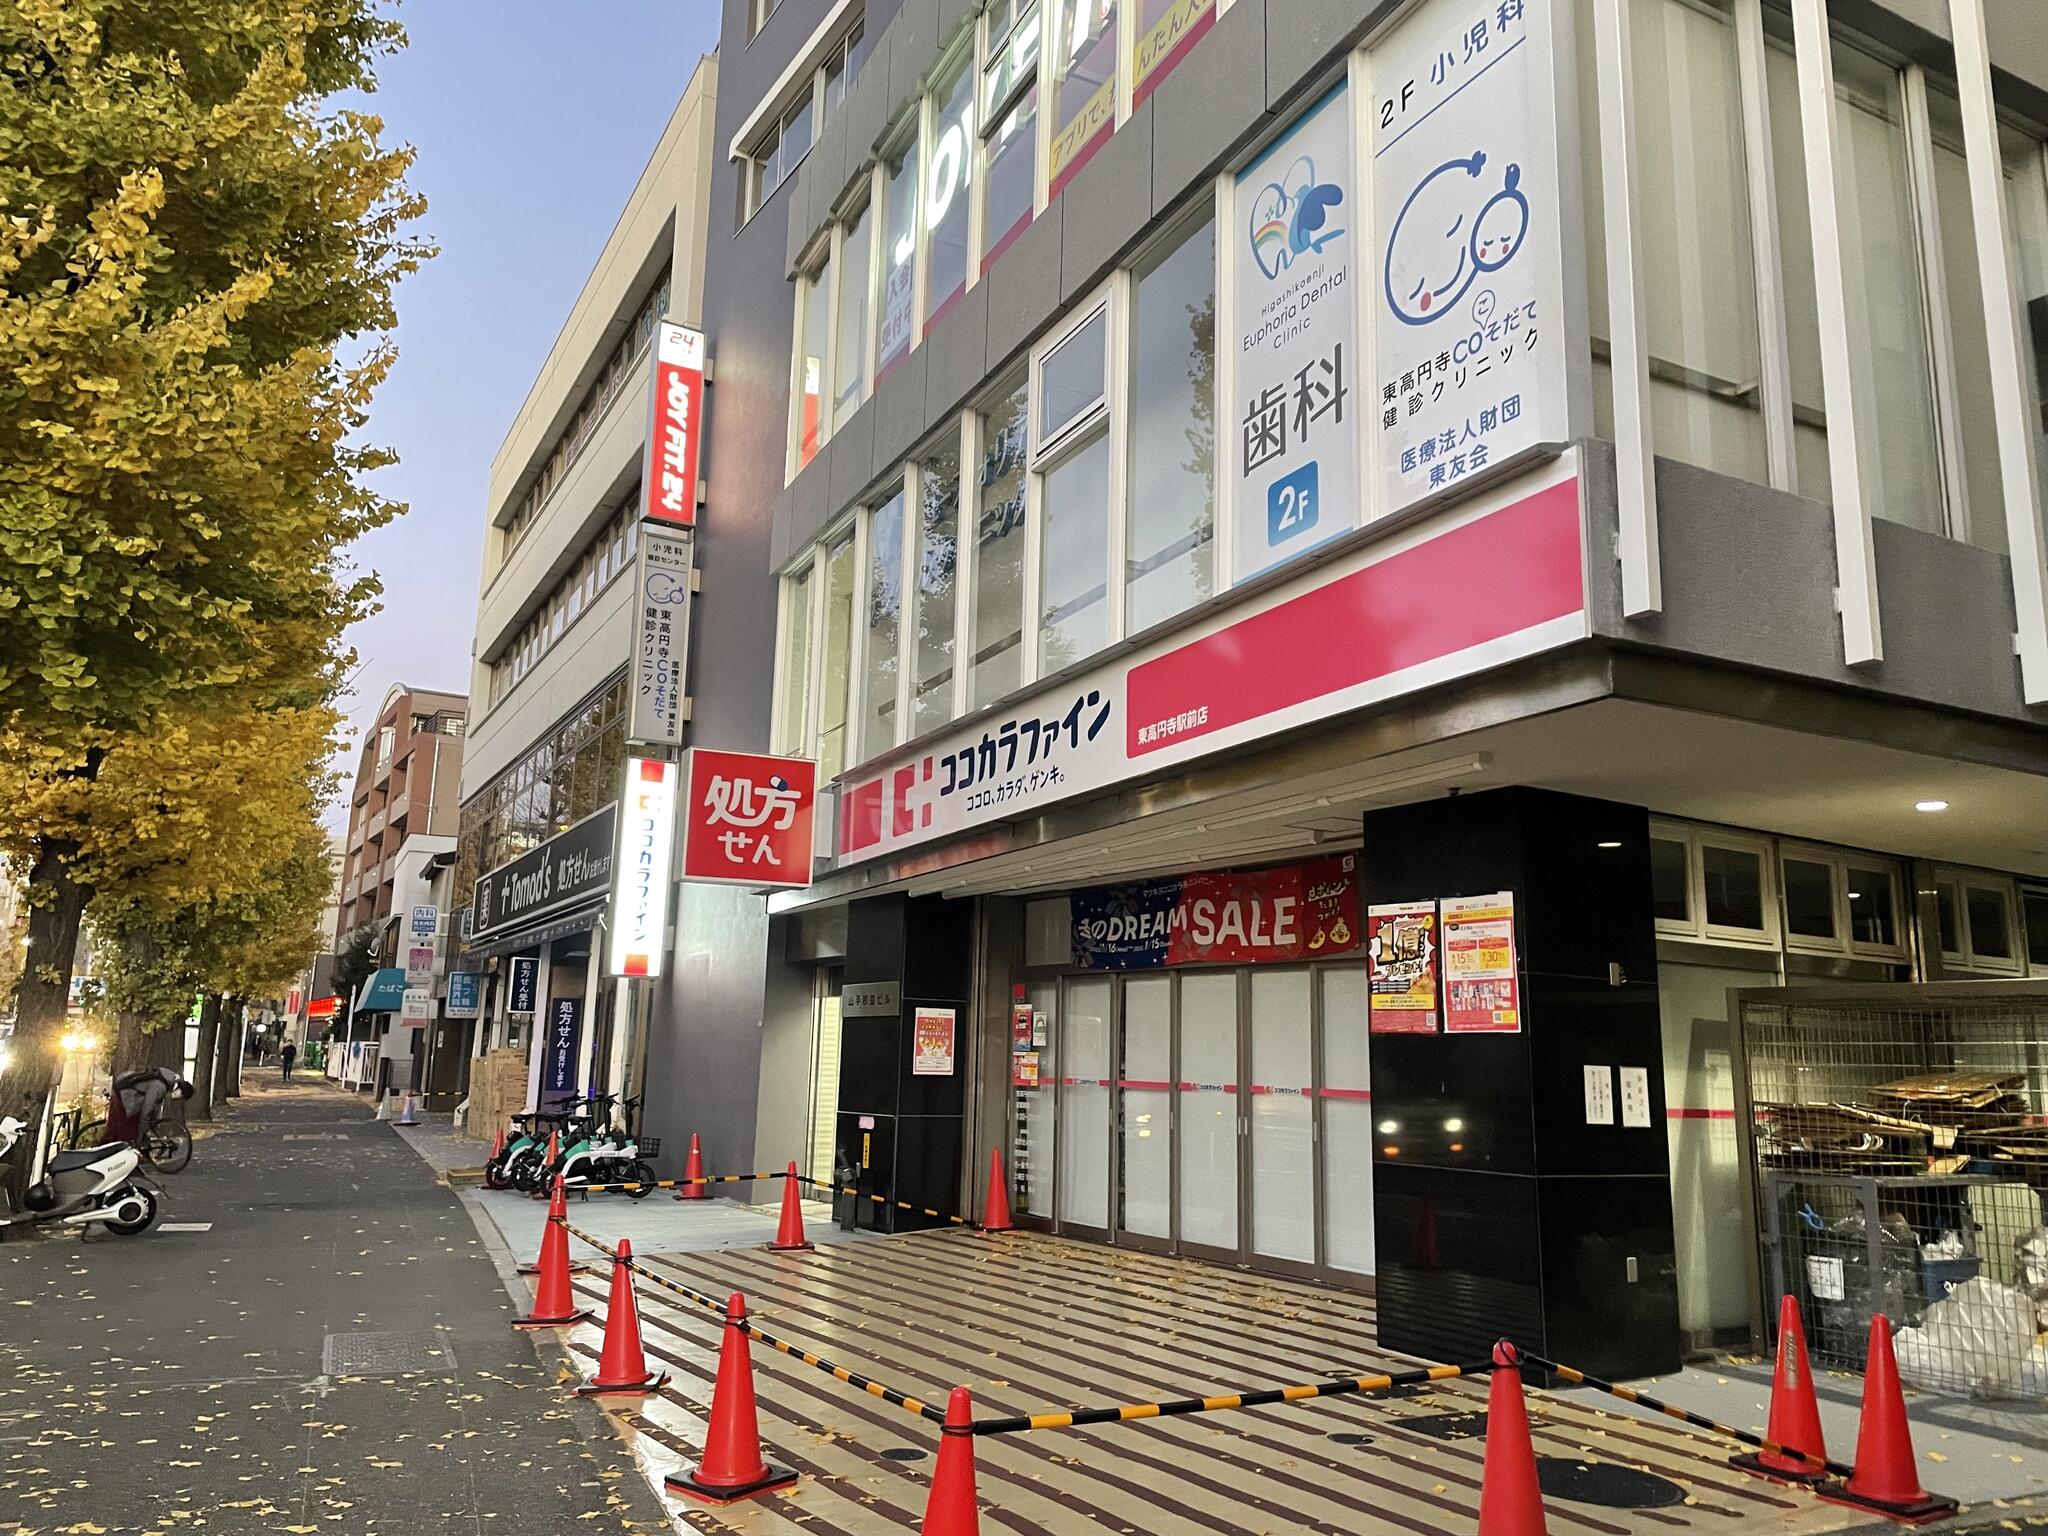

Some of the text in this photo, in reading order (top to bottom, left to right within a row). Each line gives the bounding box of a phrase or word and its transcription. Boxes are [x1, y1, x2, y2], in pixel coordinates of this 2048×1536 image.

[1381, 0, 1525, 130] 2F 小児科
[1243, 265, 1346, 352] Euphoria Dental
[1261, 263, 1325, 317] Higashikoenji
[670, 332, 694, 348] 24
[1273, 317, 1311, 349] Clinic
[1242, 342, 1348, 479] 歯科
[1401, 394, 1521, 474] 医療法人財団
[1429, 443, 1489, 490] 東友会
[1278, 485, 1309, 532] 2F
[652, 542, 683, 556] 小児科
[641, 606, 658, 696] 健診クリニック
[940, 689, 1111, 797] ココカラファイン
[1137, 704, 1209, 747] 東高円寺駅前店
[703, 774, 802, 830] 処方
[717, 831, 781, 865] せん
[510, 846, 552, 913] Tomod's
[633, 818, 654, 942] ココカラファイン
[1192, 897, 1297, 946] SALE
[518, 961, 532, 1010] 処方せん受付
[556, 1000, 574, 1049] 処方せん
